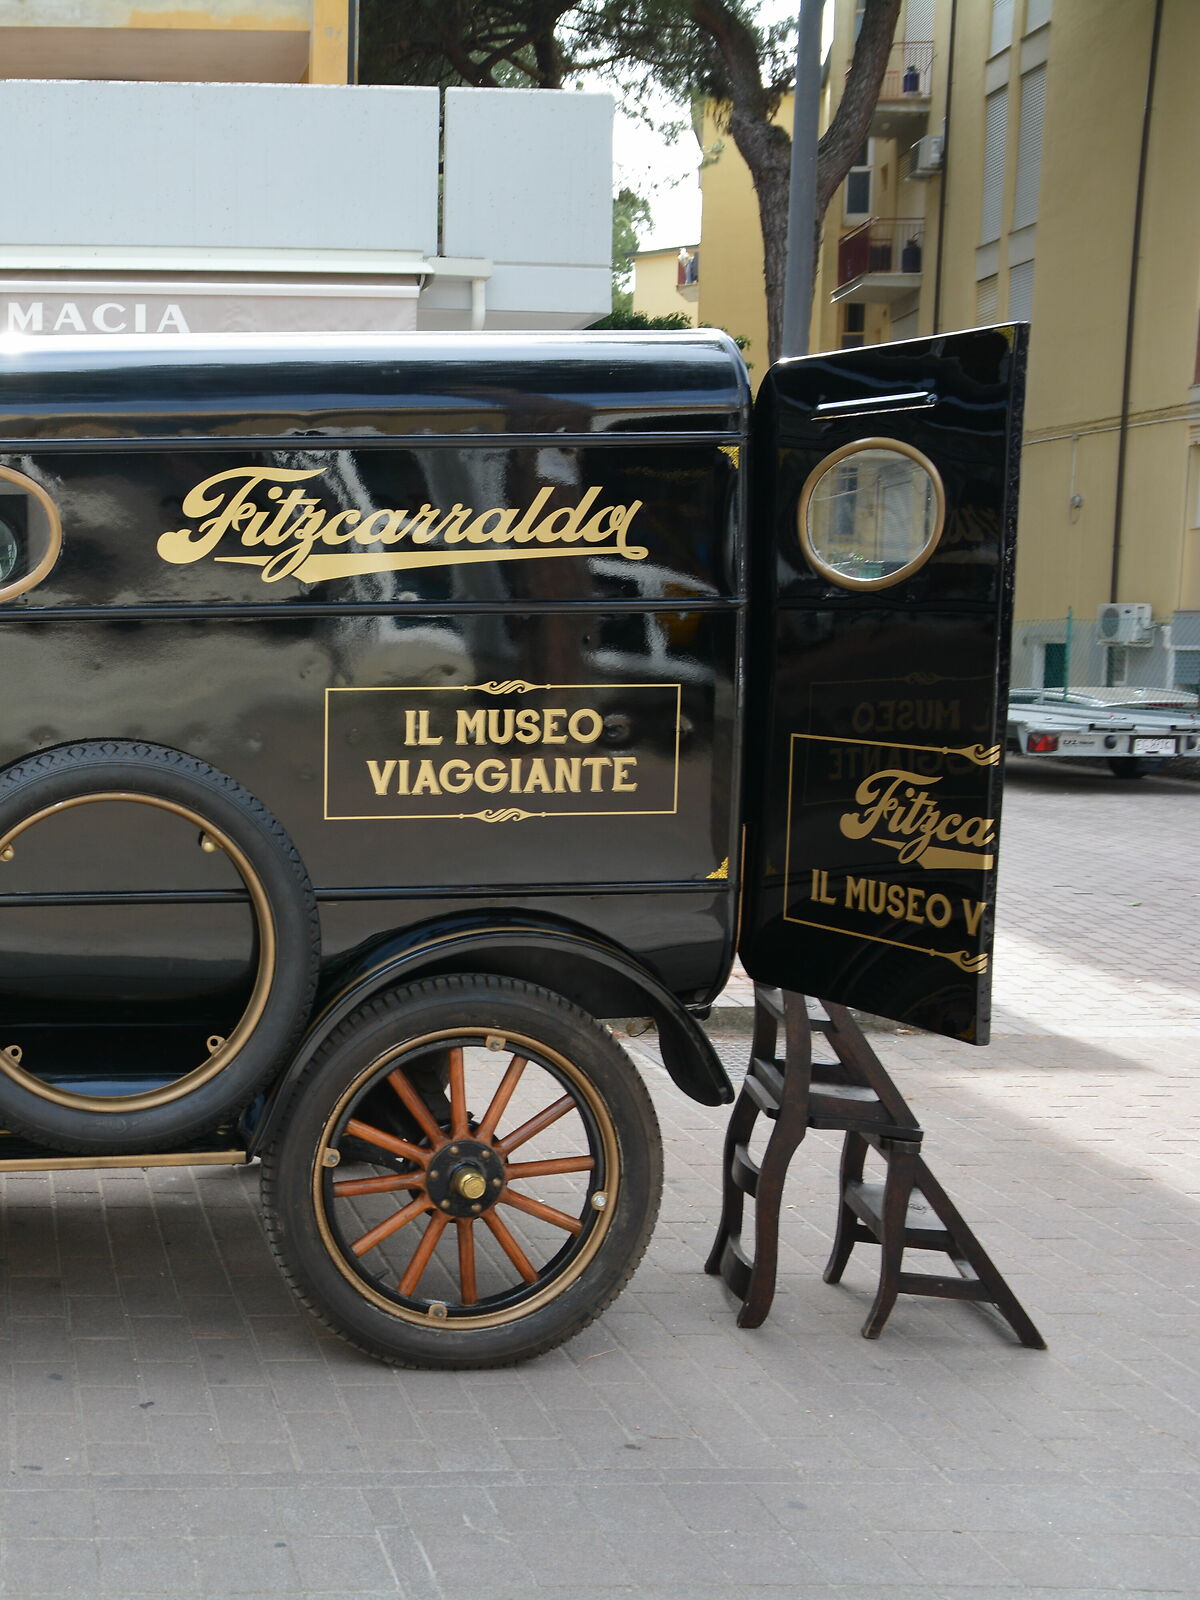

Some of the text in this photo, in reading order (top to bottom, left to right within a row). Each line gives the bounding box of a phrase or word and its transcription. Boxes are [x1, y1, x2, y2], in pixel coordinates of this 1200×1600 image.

[156, 466, 649, 583] Fitzcarraldo
[404, 708, 603, 746] IL MUSEO
[366, 757, 638, 795] VIAGGIANTE
[810, 868, 988, 937] IL MUSEO V
